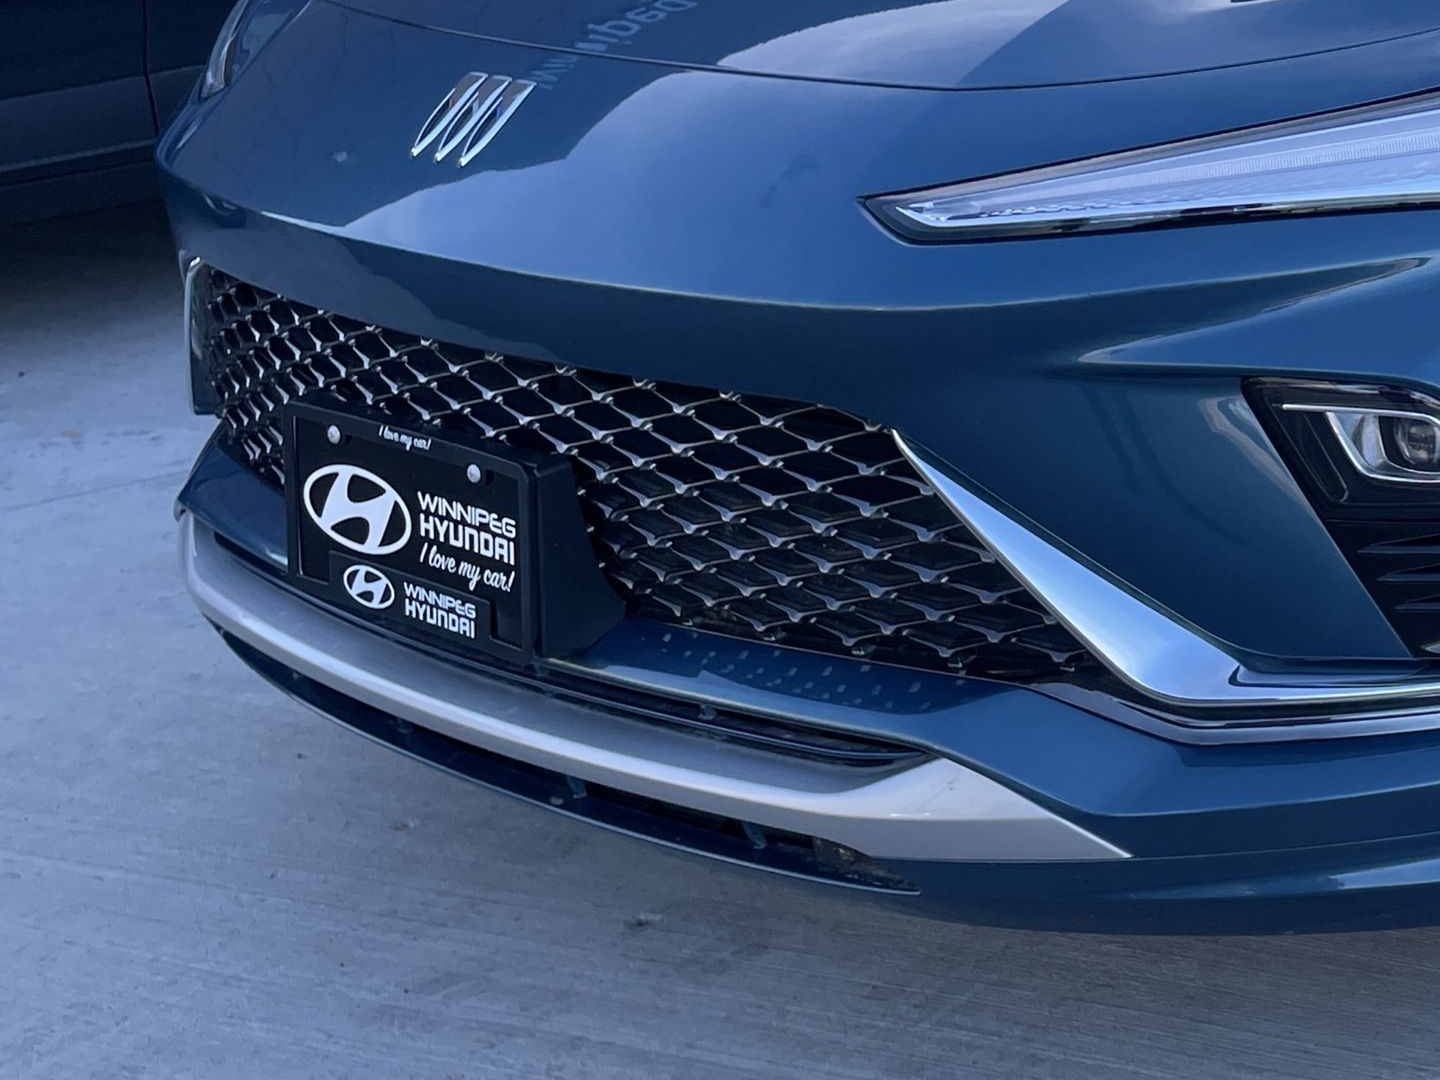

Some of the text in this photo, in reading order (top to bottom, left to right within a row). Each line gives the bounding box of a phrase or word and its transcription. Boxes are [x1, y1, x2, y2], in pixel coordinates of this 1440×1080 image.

[417, 490, 516, 539] WINNIPEG
[419, 512, 515, 566] HYUNDAI
[419, 541, 516, 593] I love my car!
[403, 580, 477, 619] WINNIPEG
[405, 597, 475, 639] HYUNDAI
